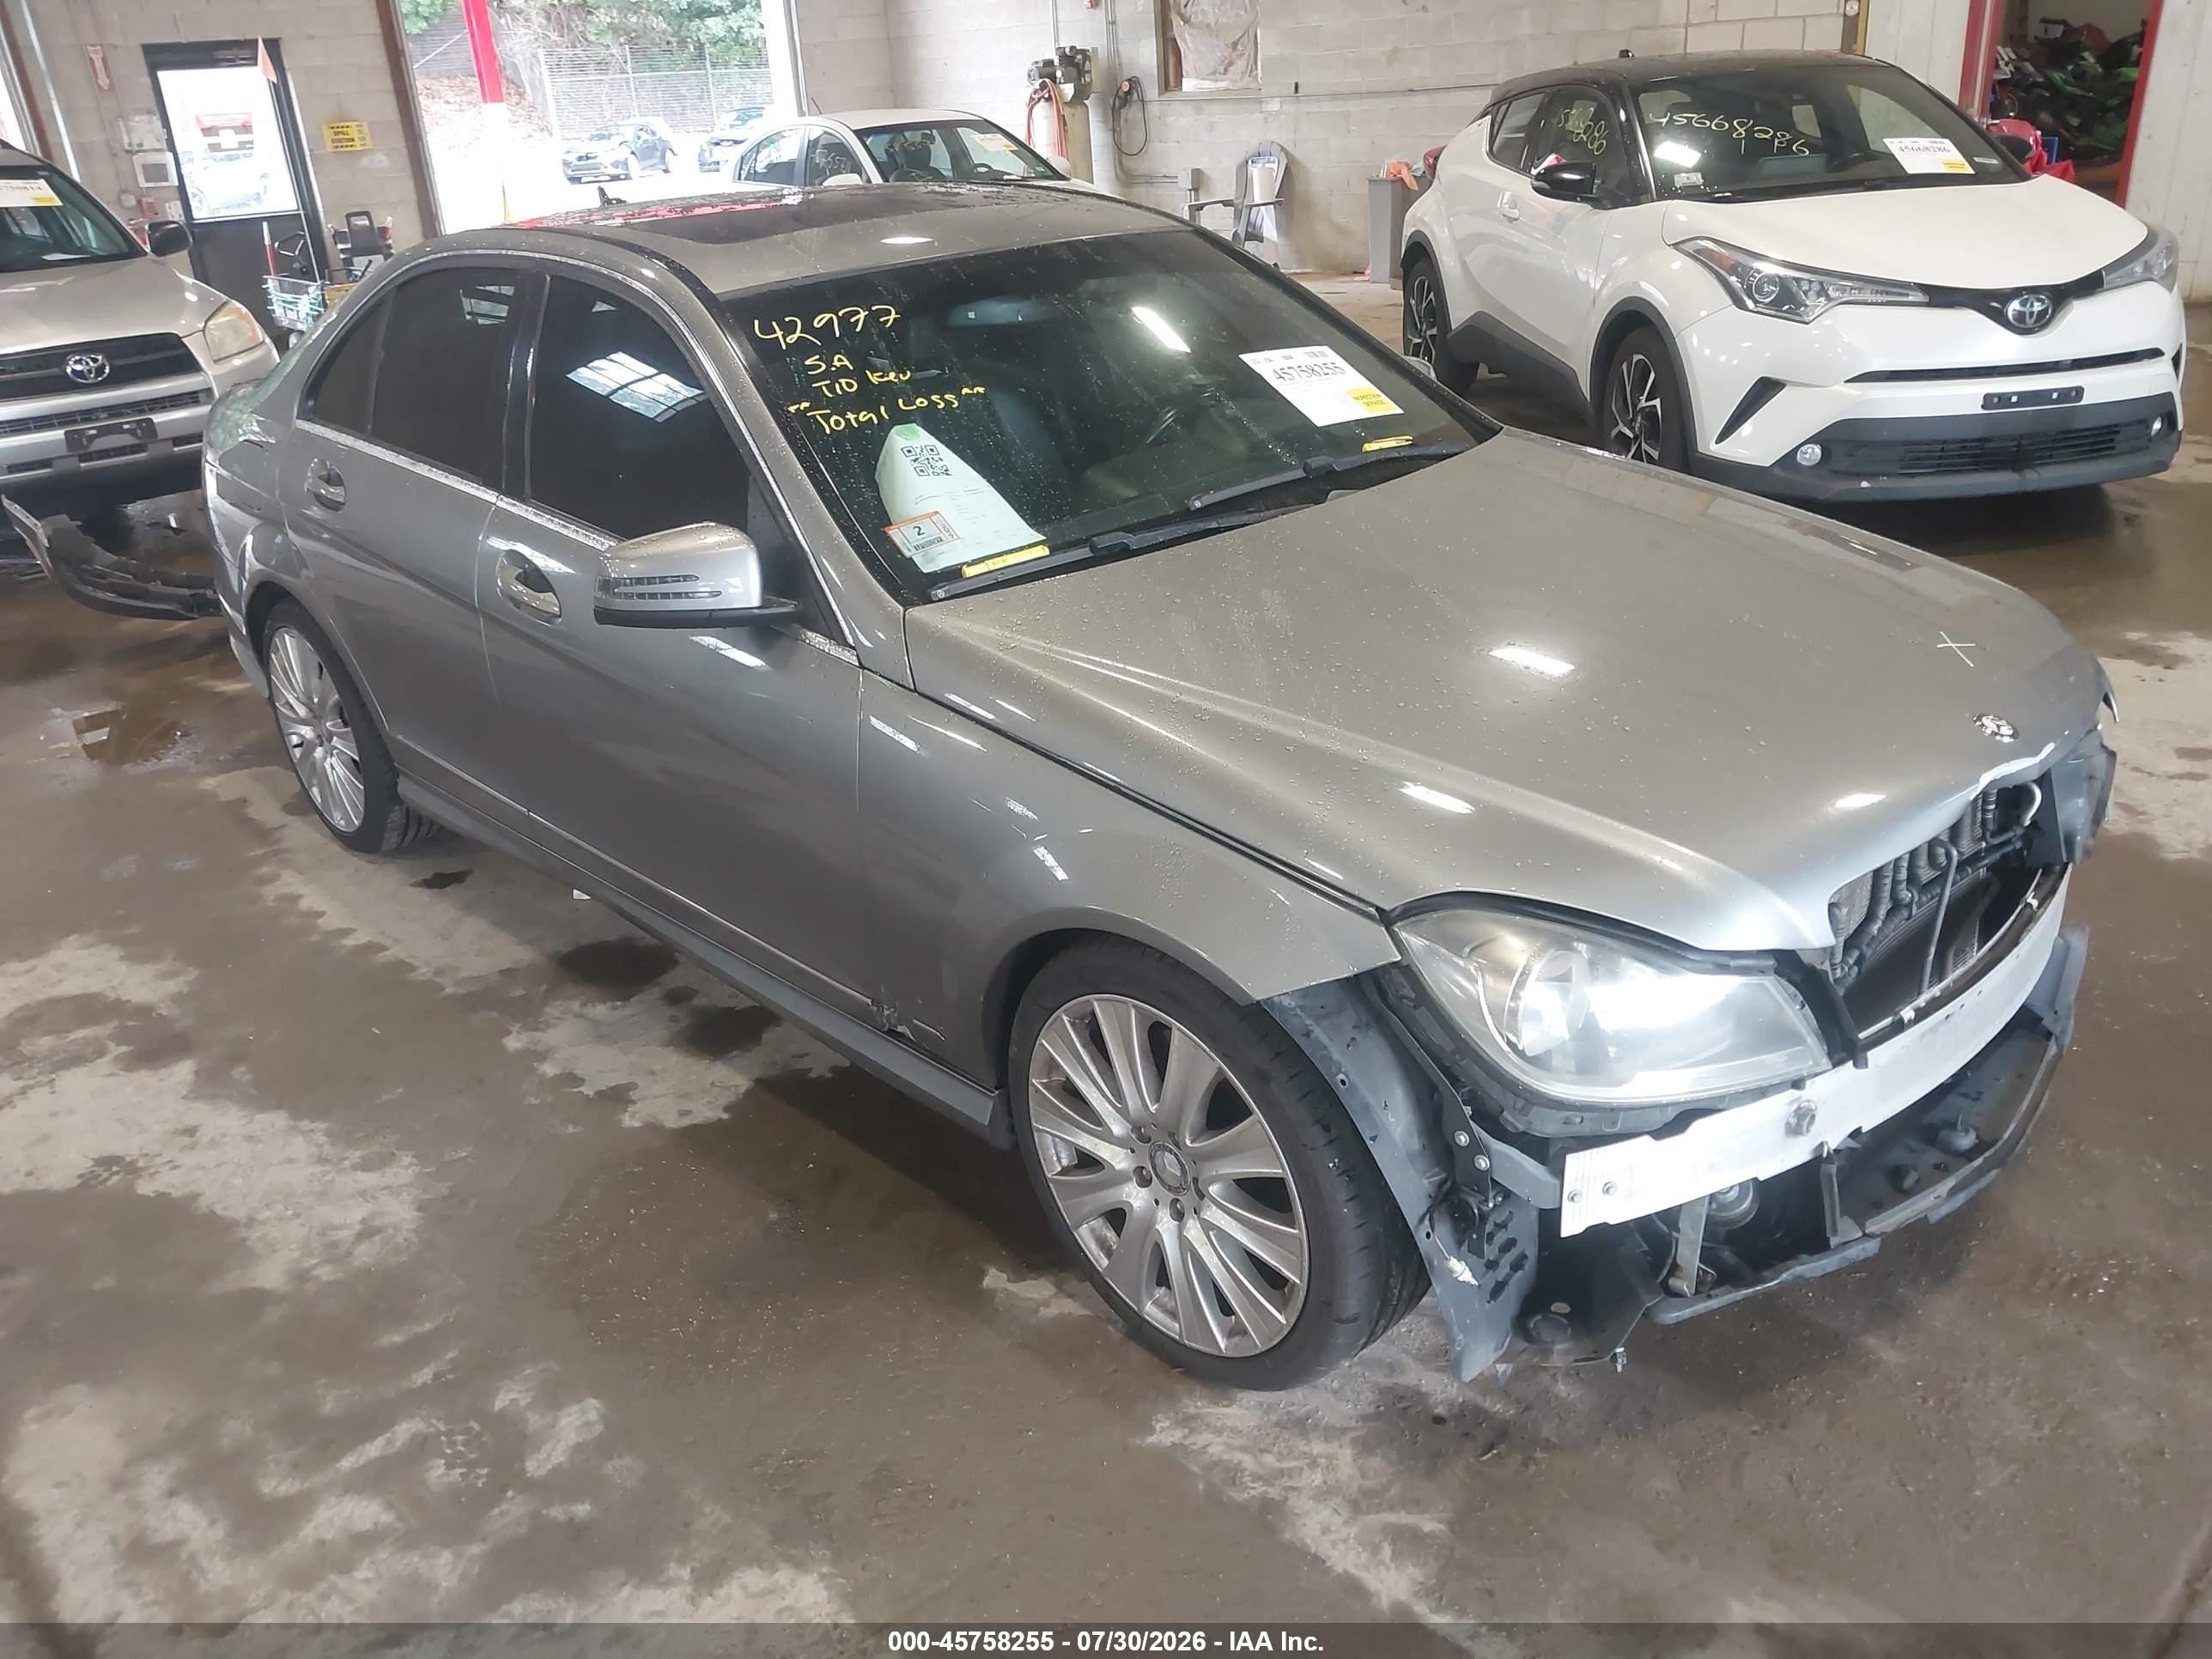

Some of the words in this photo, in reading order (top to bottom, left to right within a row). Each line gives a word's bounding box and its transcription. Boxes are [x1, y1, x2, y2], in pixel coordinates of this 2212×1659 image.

[753, 305, 901, 350] 42977
[1273, 362, 1346, 382] 45758255
[913, 526, 926, 537] 2
